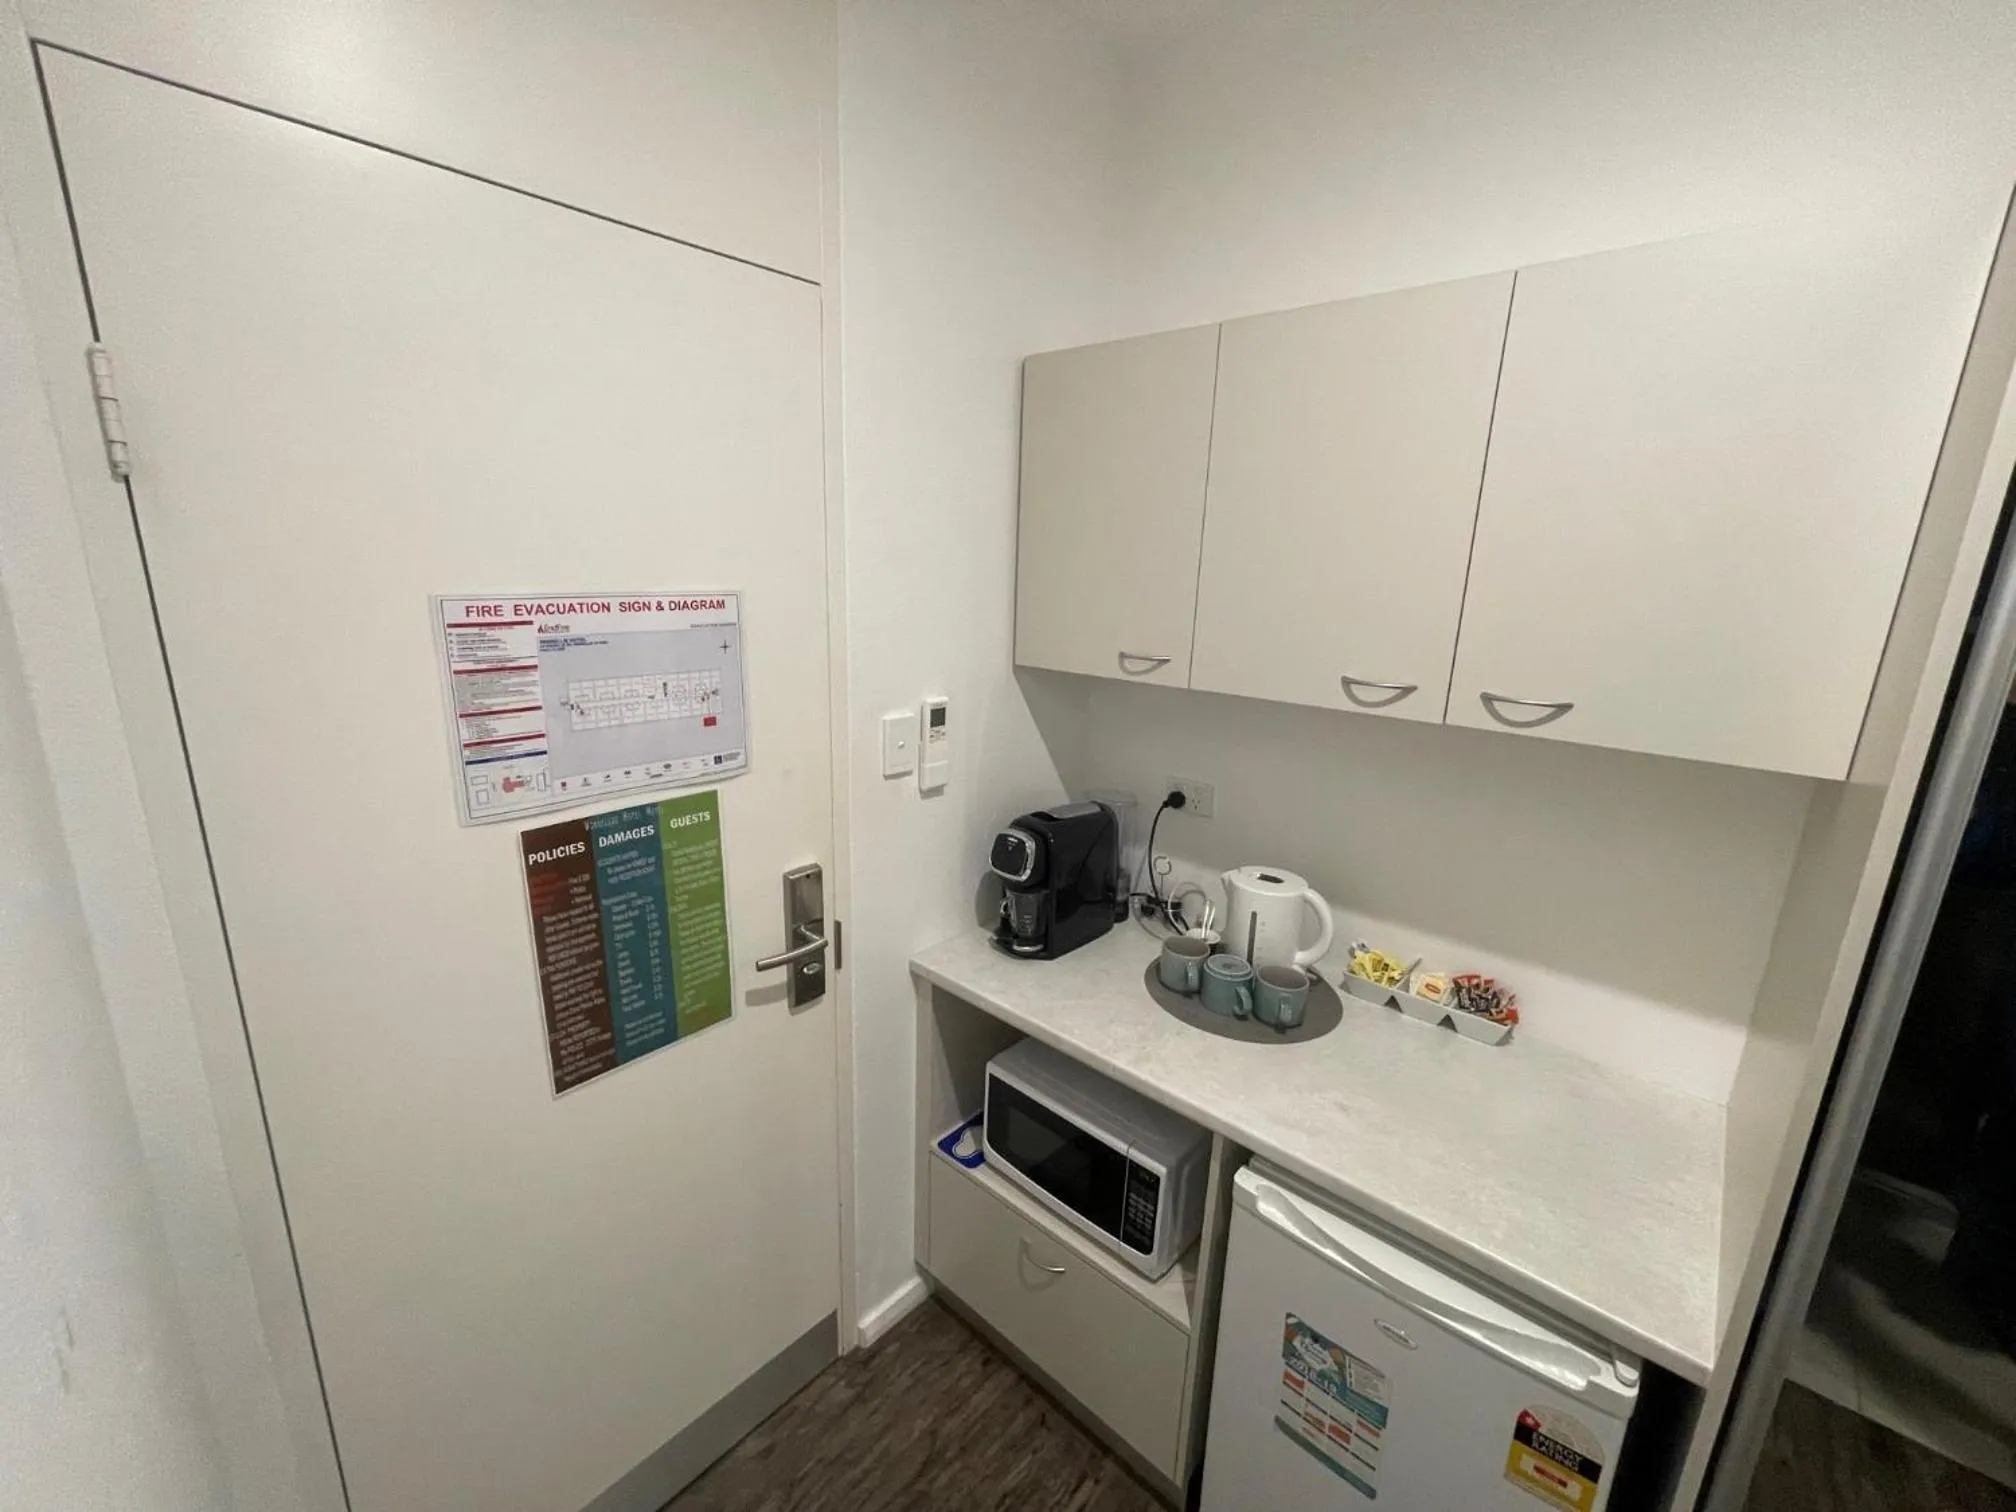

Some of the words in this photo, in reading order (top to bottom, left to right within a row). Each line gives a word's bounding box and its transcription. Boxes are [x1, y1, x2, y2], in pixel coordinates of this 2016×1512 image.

[465, 604, 504, 618] FIRE
[514, 602, 611, 617] EVACUATION
[619, 600, 651, 613] SIGN
[655, 600, 665, 611] &
[668, 599, 726, 612] DIAGRAM
[670, 811, 711, 829] GUESTS
[598, 825, 655, 848] DAMAGES
[528, 841, 586, 866] POLICIES
